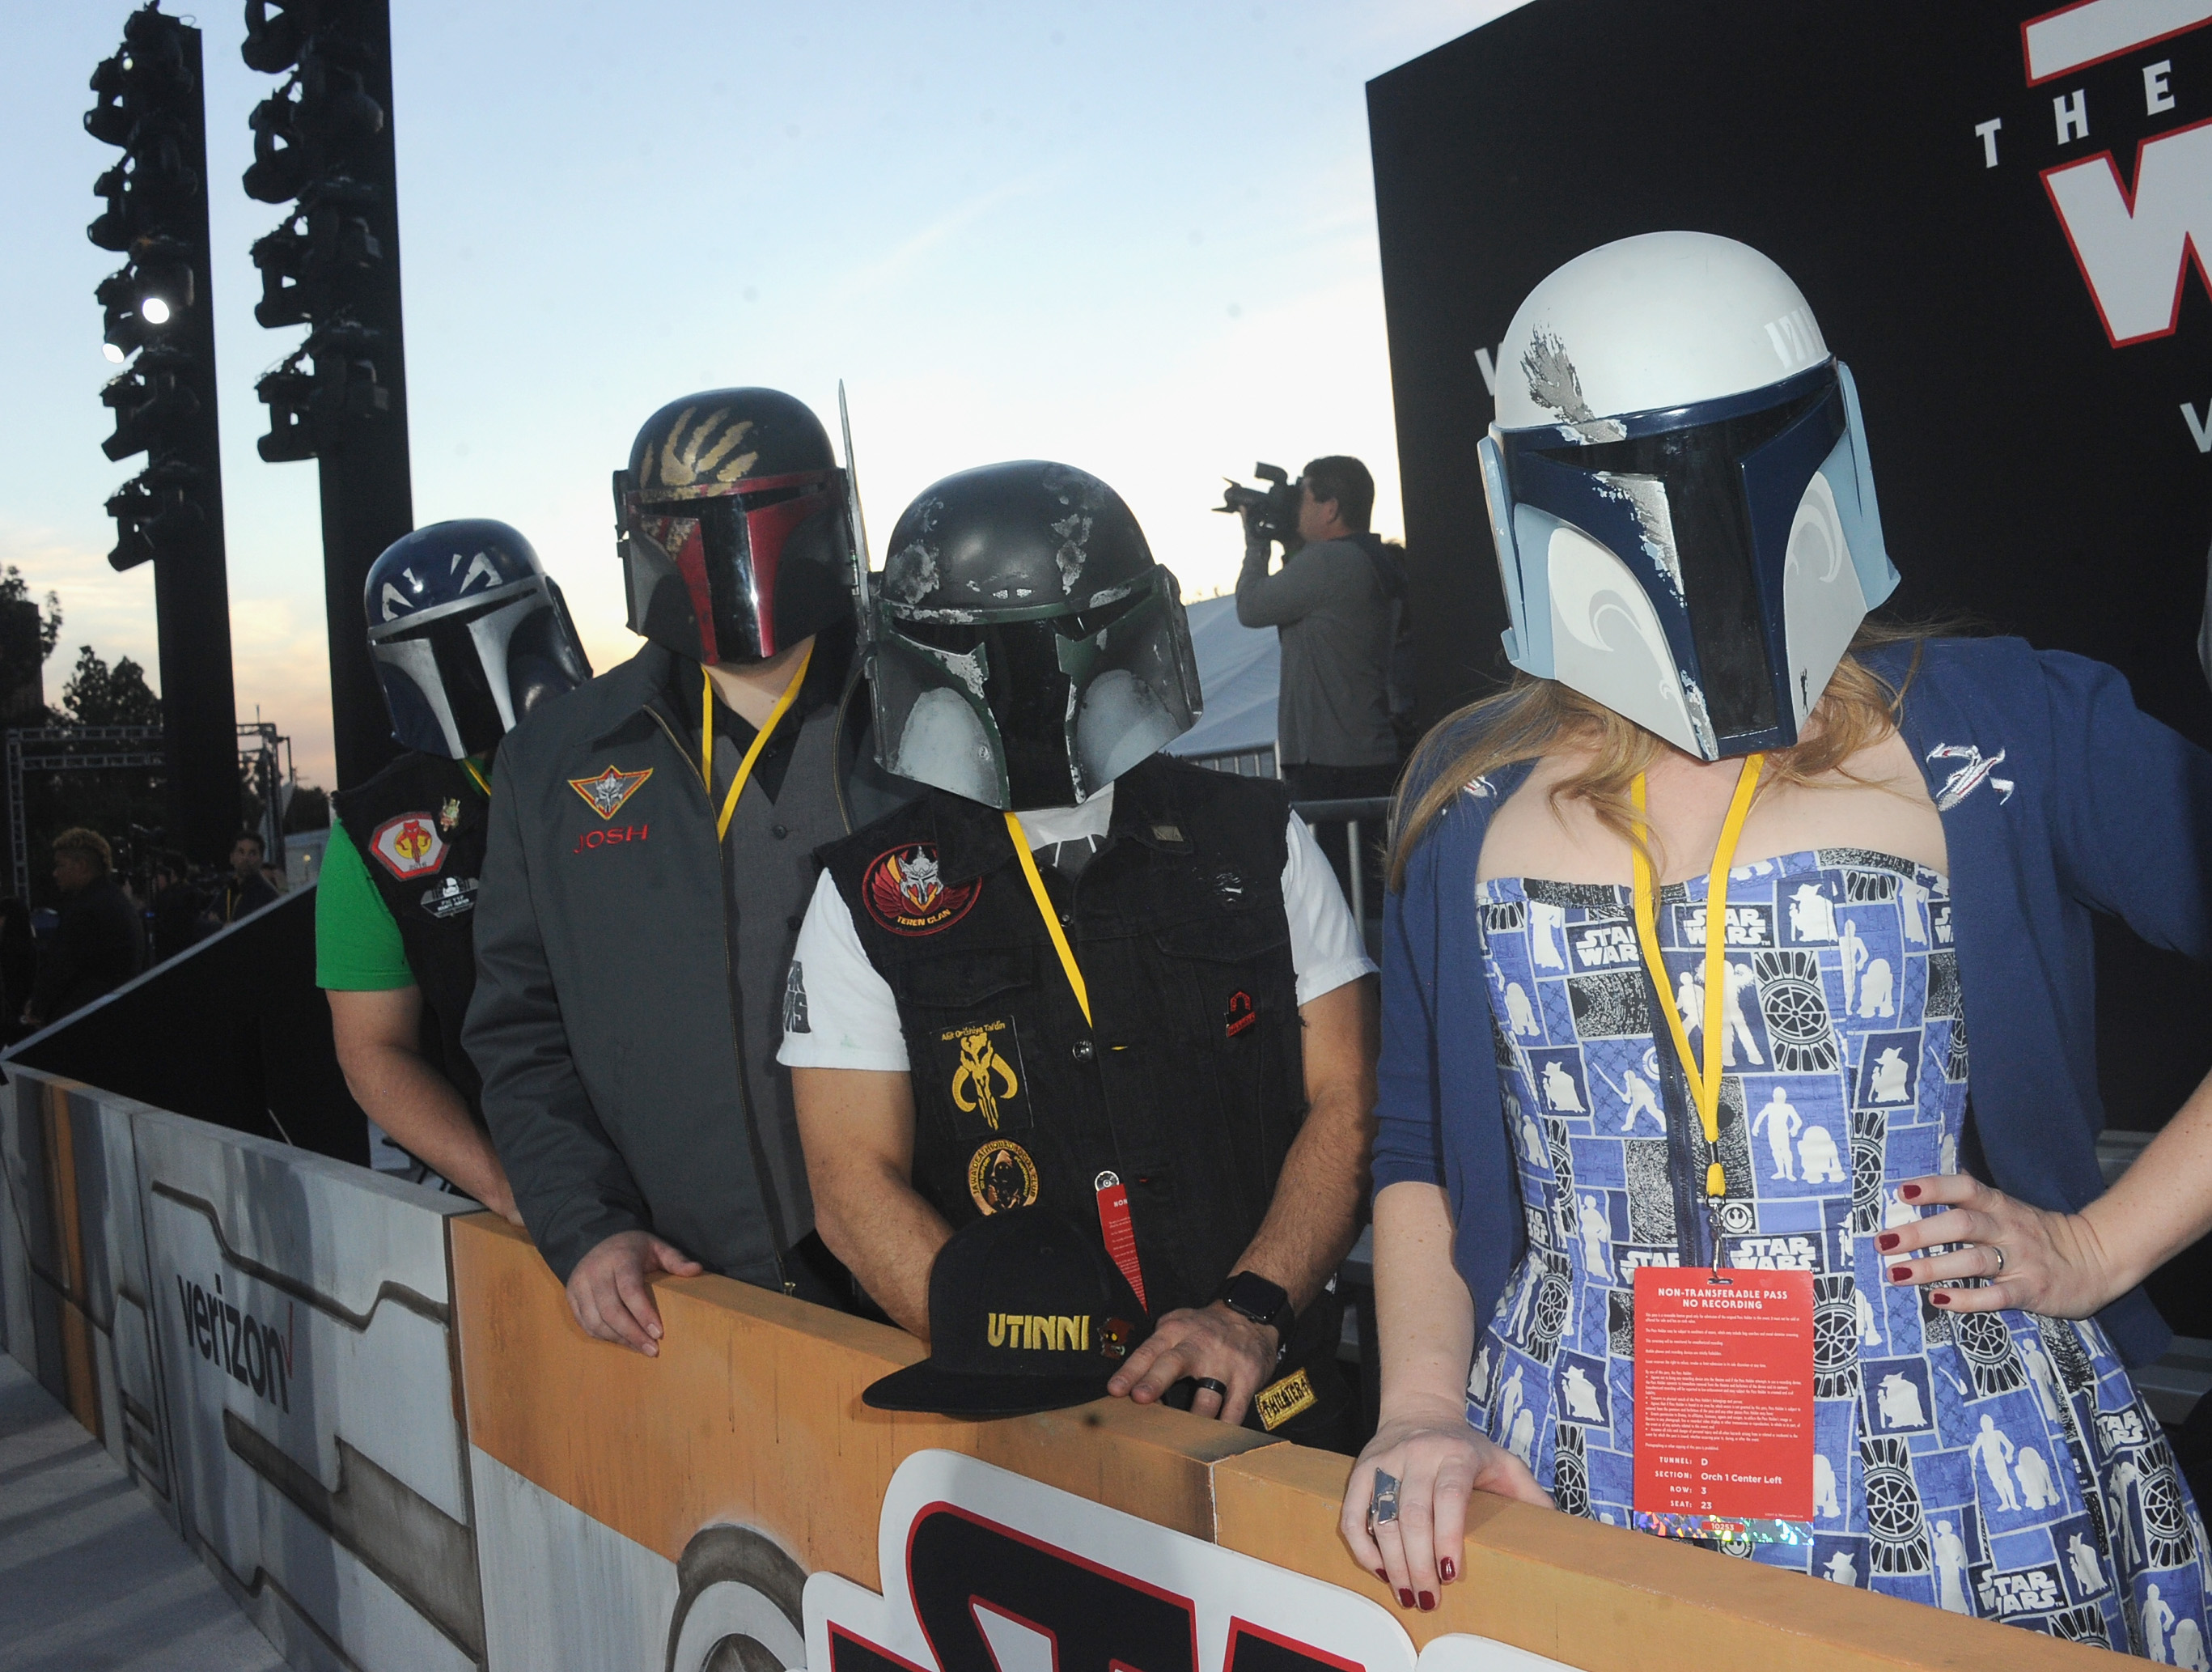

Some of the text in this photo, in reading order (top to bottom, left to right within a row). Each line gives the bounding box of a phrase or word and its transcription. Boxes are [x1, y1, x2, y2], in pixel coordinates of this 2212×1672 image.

[1975, 59, 2176, 168] THE
[574, 824, 648, 853] JOSH
[896, 909, 951, 927] TEREN CLAN
[1684, 909, 1765, 927] SAR
[1684, 927, 1765, 944] WRS
[971, 1170, 980, 1195] JAWA
[1731, 1237, 1816, 1256] STAR
[1658, 1288, 1788, 1300] NON-TRANSFERABLE PASS
[1683, 1299, 1762, 1309] NO RECORDING
[987, 1313, 1090, 1351] UTINNI
[177, 1273, 289, 1414] verizon
[2096, 1410, 2142, 1435] TAR
[1659, 1457, 1709, 1466] TUNNEL: D
[1655, 1470, 1692, 1479] SECTION:
[1701, 1473, 1723, 1481] Orch
[1731, 1475, 1761, 1483] Center
[1764, 1476, 1782, 1484] Left
[1701, 1487, 1707, 1495] 3
[1701, 1501, 1712, 1509] 23
[1711, 1522, 1735, 1530] 10253
[1977, 1568, 2056, 1597] STAR
[1979, 1588, 2057, 1617] WARS
